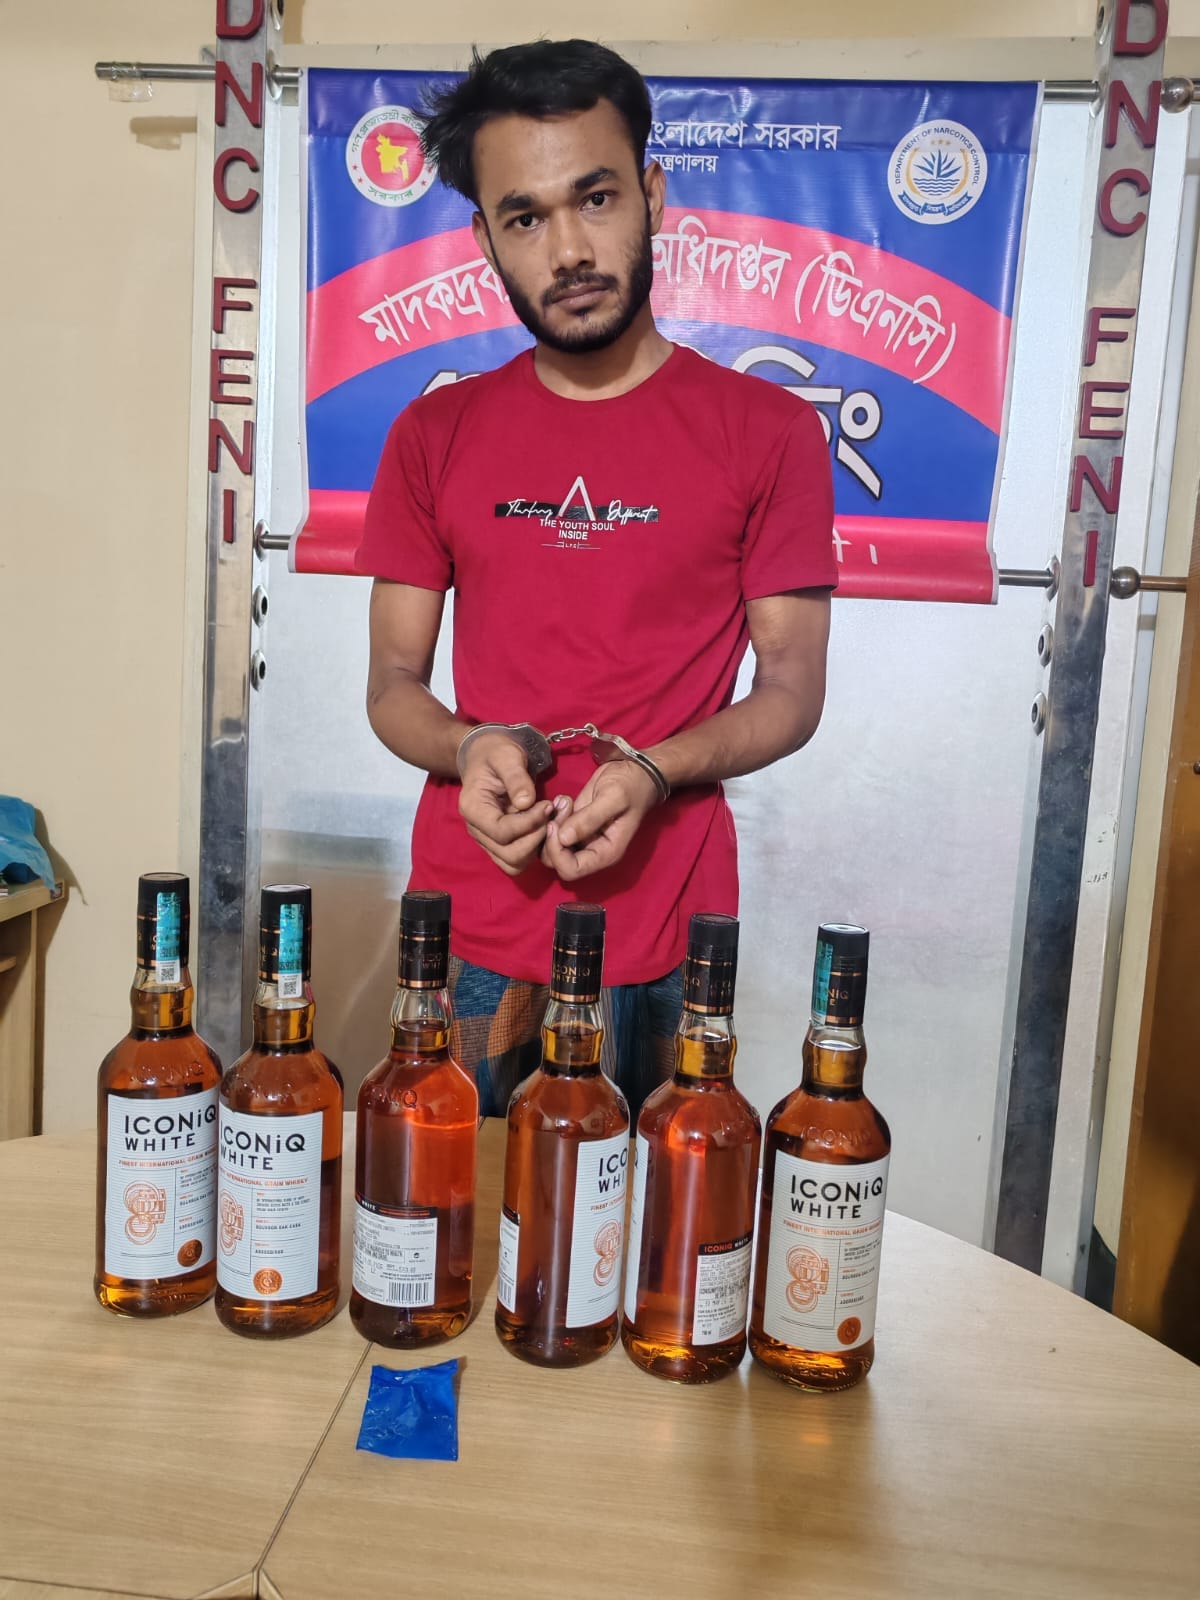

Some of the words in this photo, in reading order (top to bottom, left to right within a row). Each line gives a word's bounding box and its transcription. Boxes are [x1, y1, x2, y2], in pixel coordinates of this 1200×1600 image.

[1098, 0, 1169, 237] DNC
[753, 122, 842, 151] সরকার
[895, 134, 920, 185] DEPARTMENT
[921, 129, 933, 138] OF
[934, 127, 974, 150] NARCOTICS
[970, 148, 980, 185] CONTROL
[358, 257, 510, 345] মাদকদ্রব
[795, 251, 956, 384] (ডিএনসি)
[208, 277, 257, 544] FENI
[1069, 307, 1137, 587] FENI
[540, 519, 556, 528] THE
[559, 521, 589, 531] YOUTH
[591, 521, 615, 532] SOUL
[558, 529, 588, 540] INSIDE
[125, 1104, 217, 1135] ICONiQ
[125, 1132, 196, 1152] WHITE
[221, 1143, 273, 1171] WHITE
[791, 1175, 883, 1203] ICONiQ
[791, 1197, 862, 1219] WHITE
